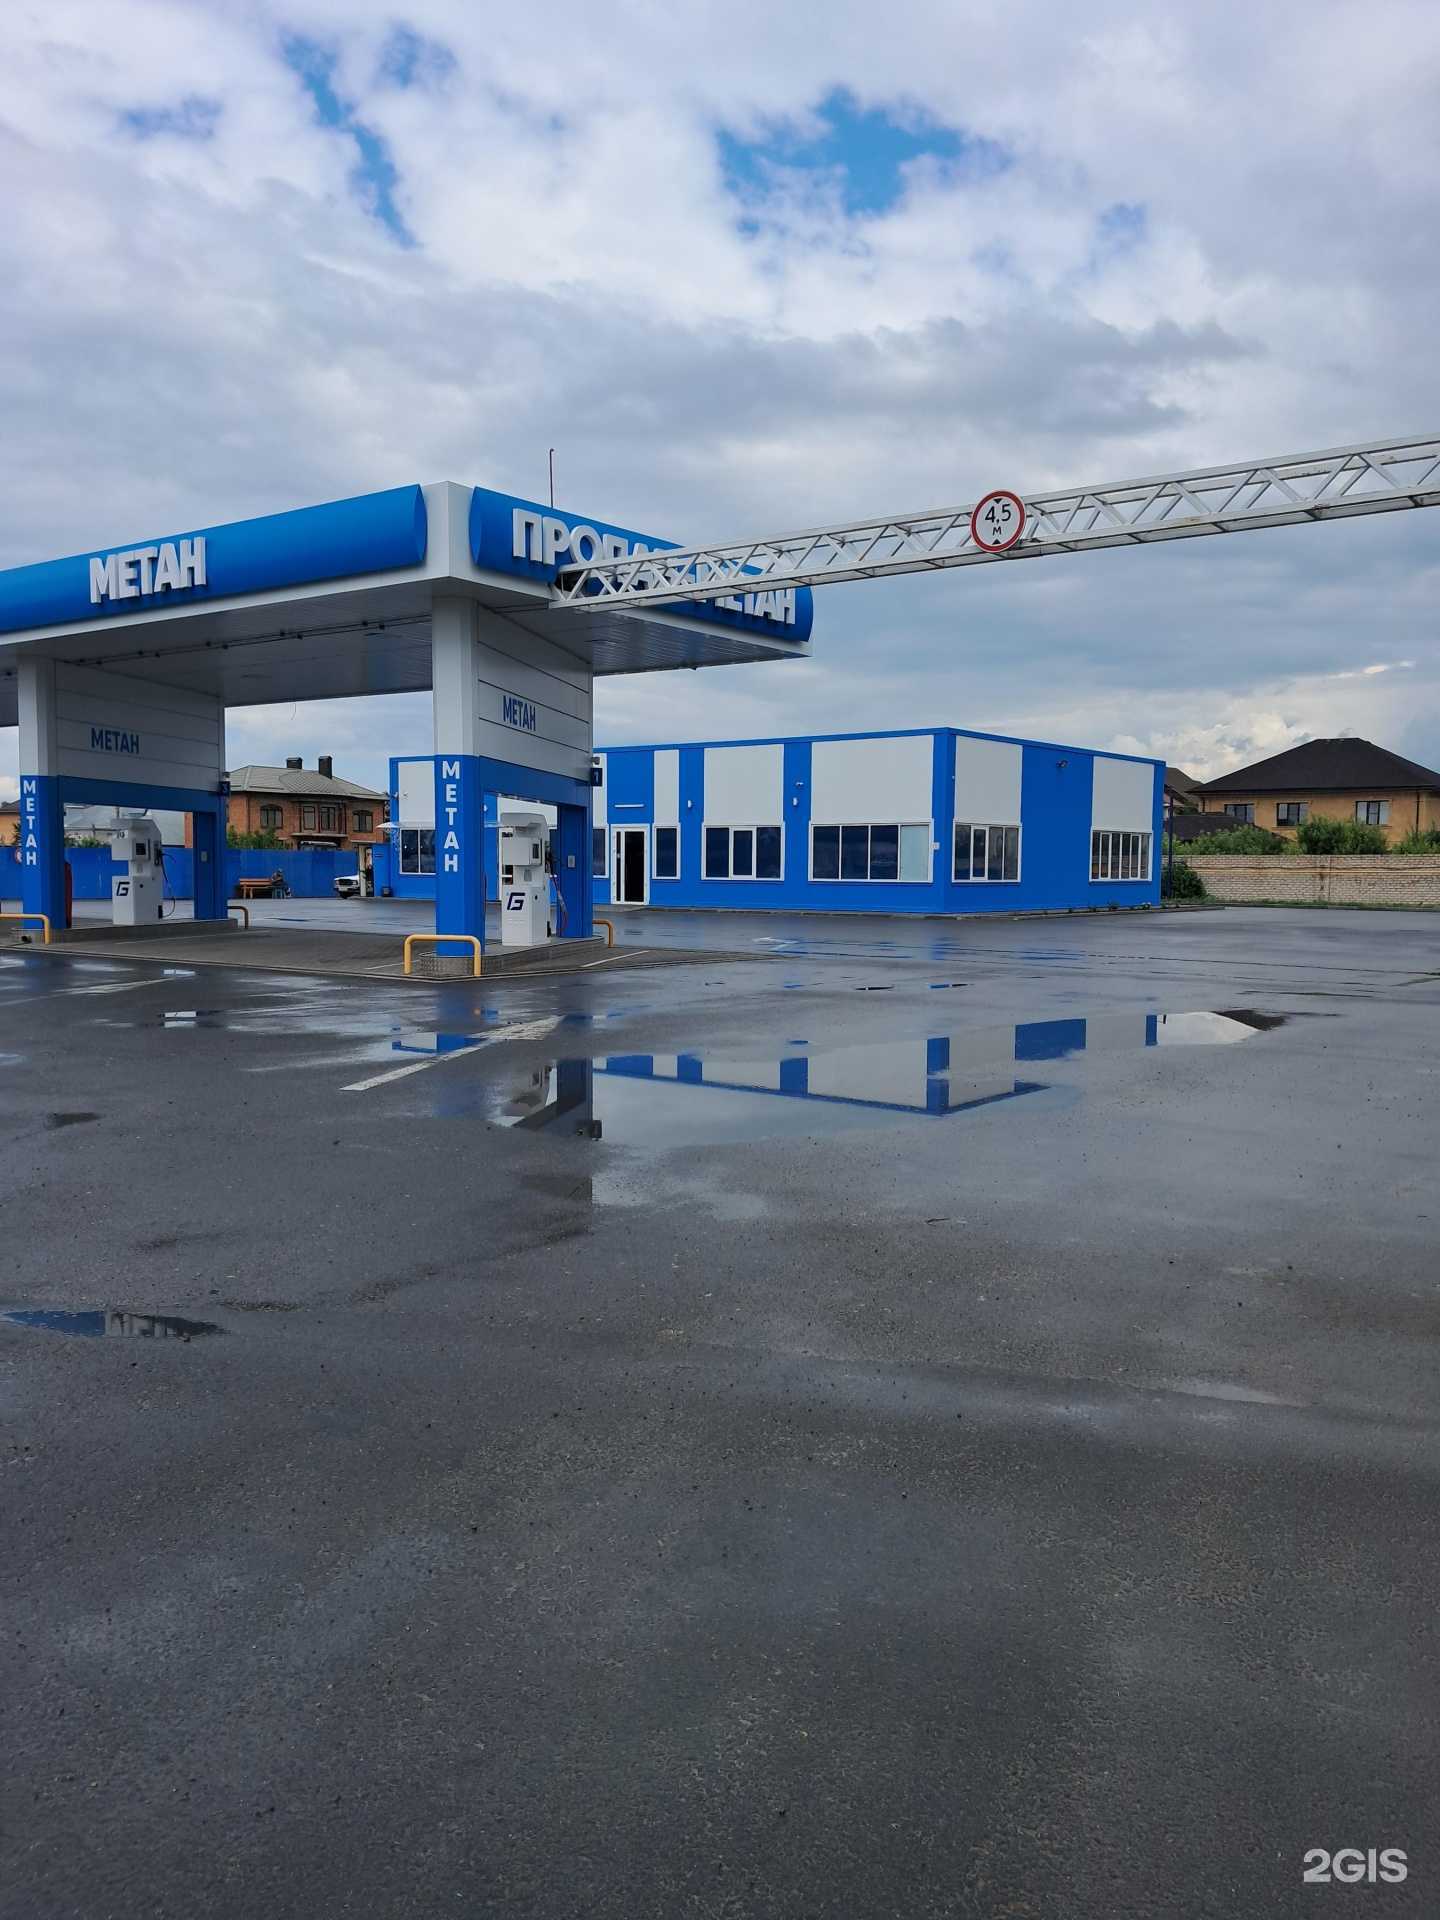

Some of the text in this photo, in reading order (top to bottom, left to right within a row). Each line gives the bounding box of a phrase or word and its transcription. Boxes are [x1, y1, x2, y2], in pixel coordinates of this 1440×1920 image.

[985, 504, 1011, 525] 4,5
[90, 536, 206, 604] МЕТАН
[503, 695, 536, 732] МЕТАН
[91, 727, 140, 755] МЕТАН
[23, 779, 38, 866] МЕТАН
[441, 760, 460, 873] МЕТАН
